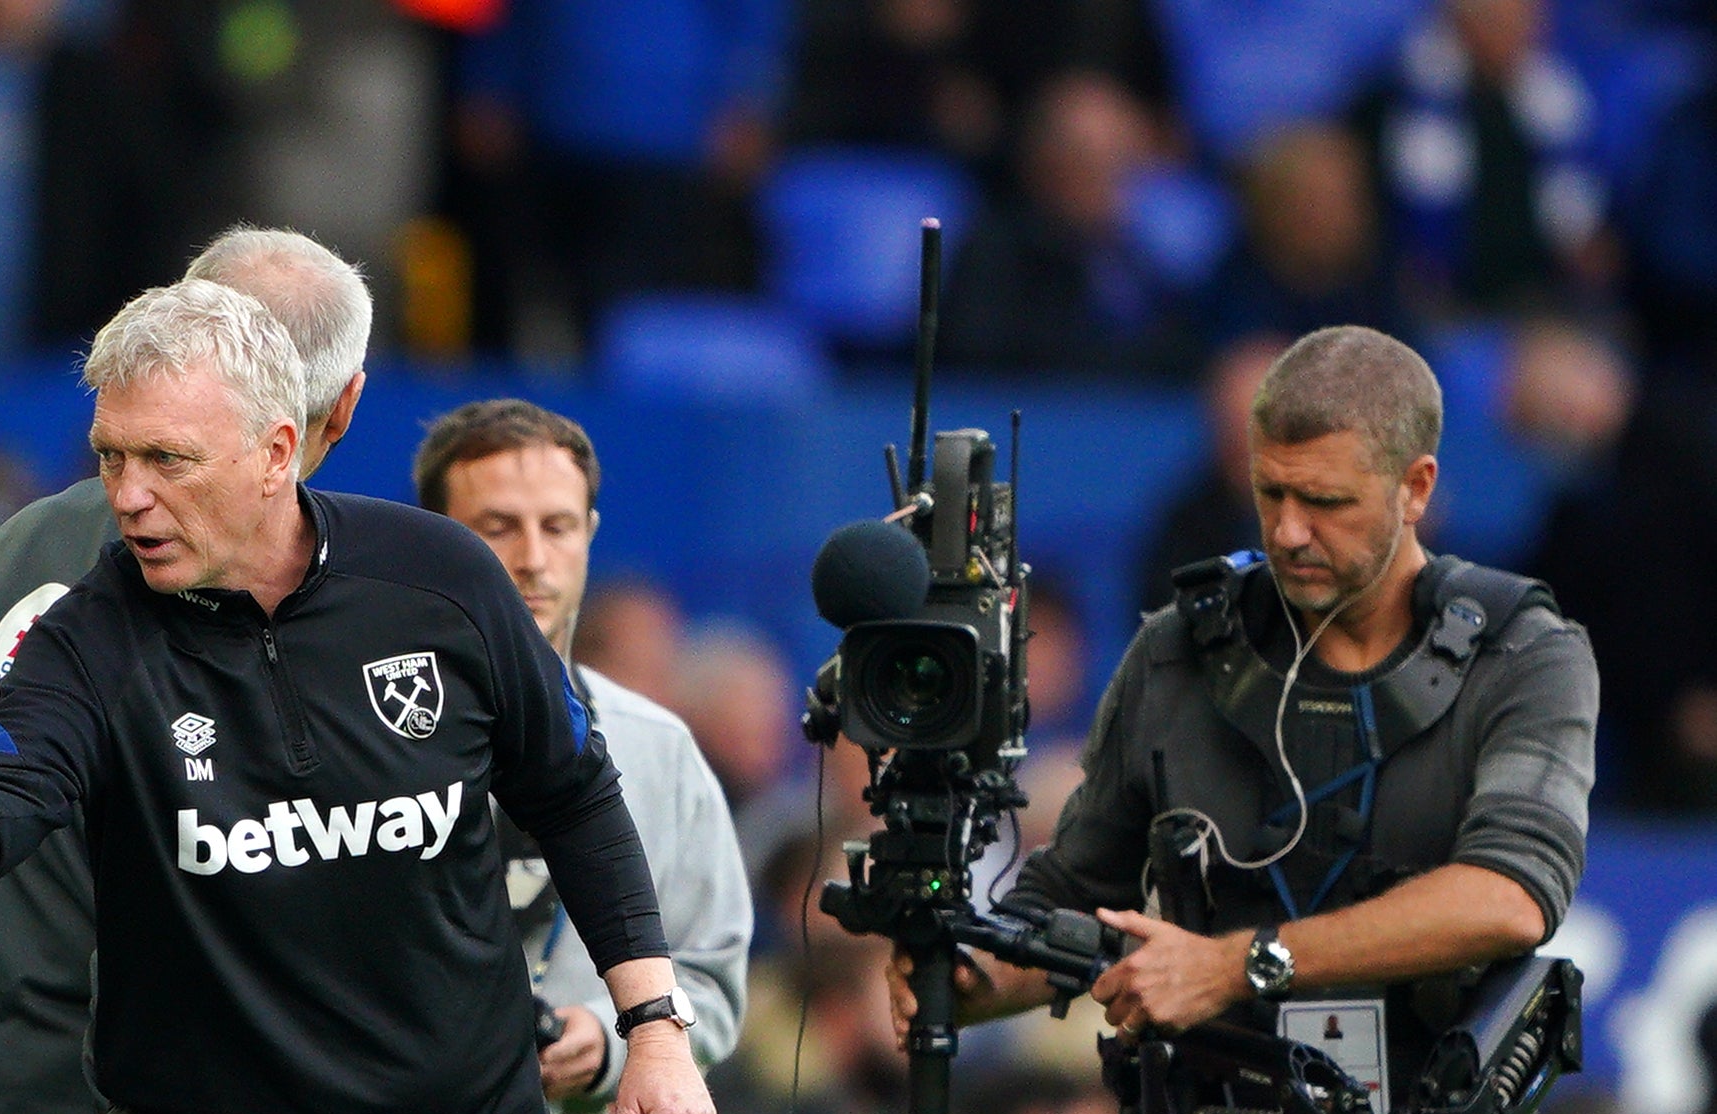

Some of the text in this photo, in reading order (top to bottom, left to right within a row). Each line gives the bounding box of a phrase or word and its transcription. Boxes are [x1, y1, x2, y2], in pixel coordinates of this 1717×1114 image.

[371, 657, 429, 678] WEST HAM
[184, 757, 215, 782] DM
[177, 780, 464, 876] betway
